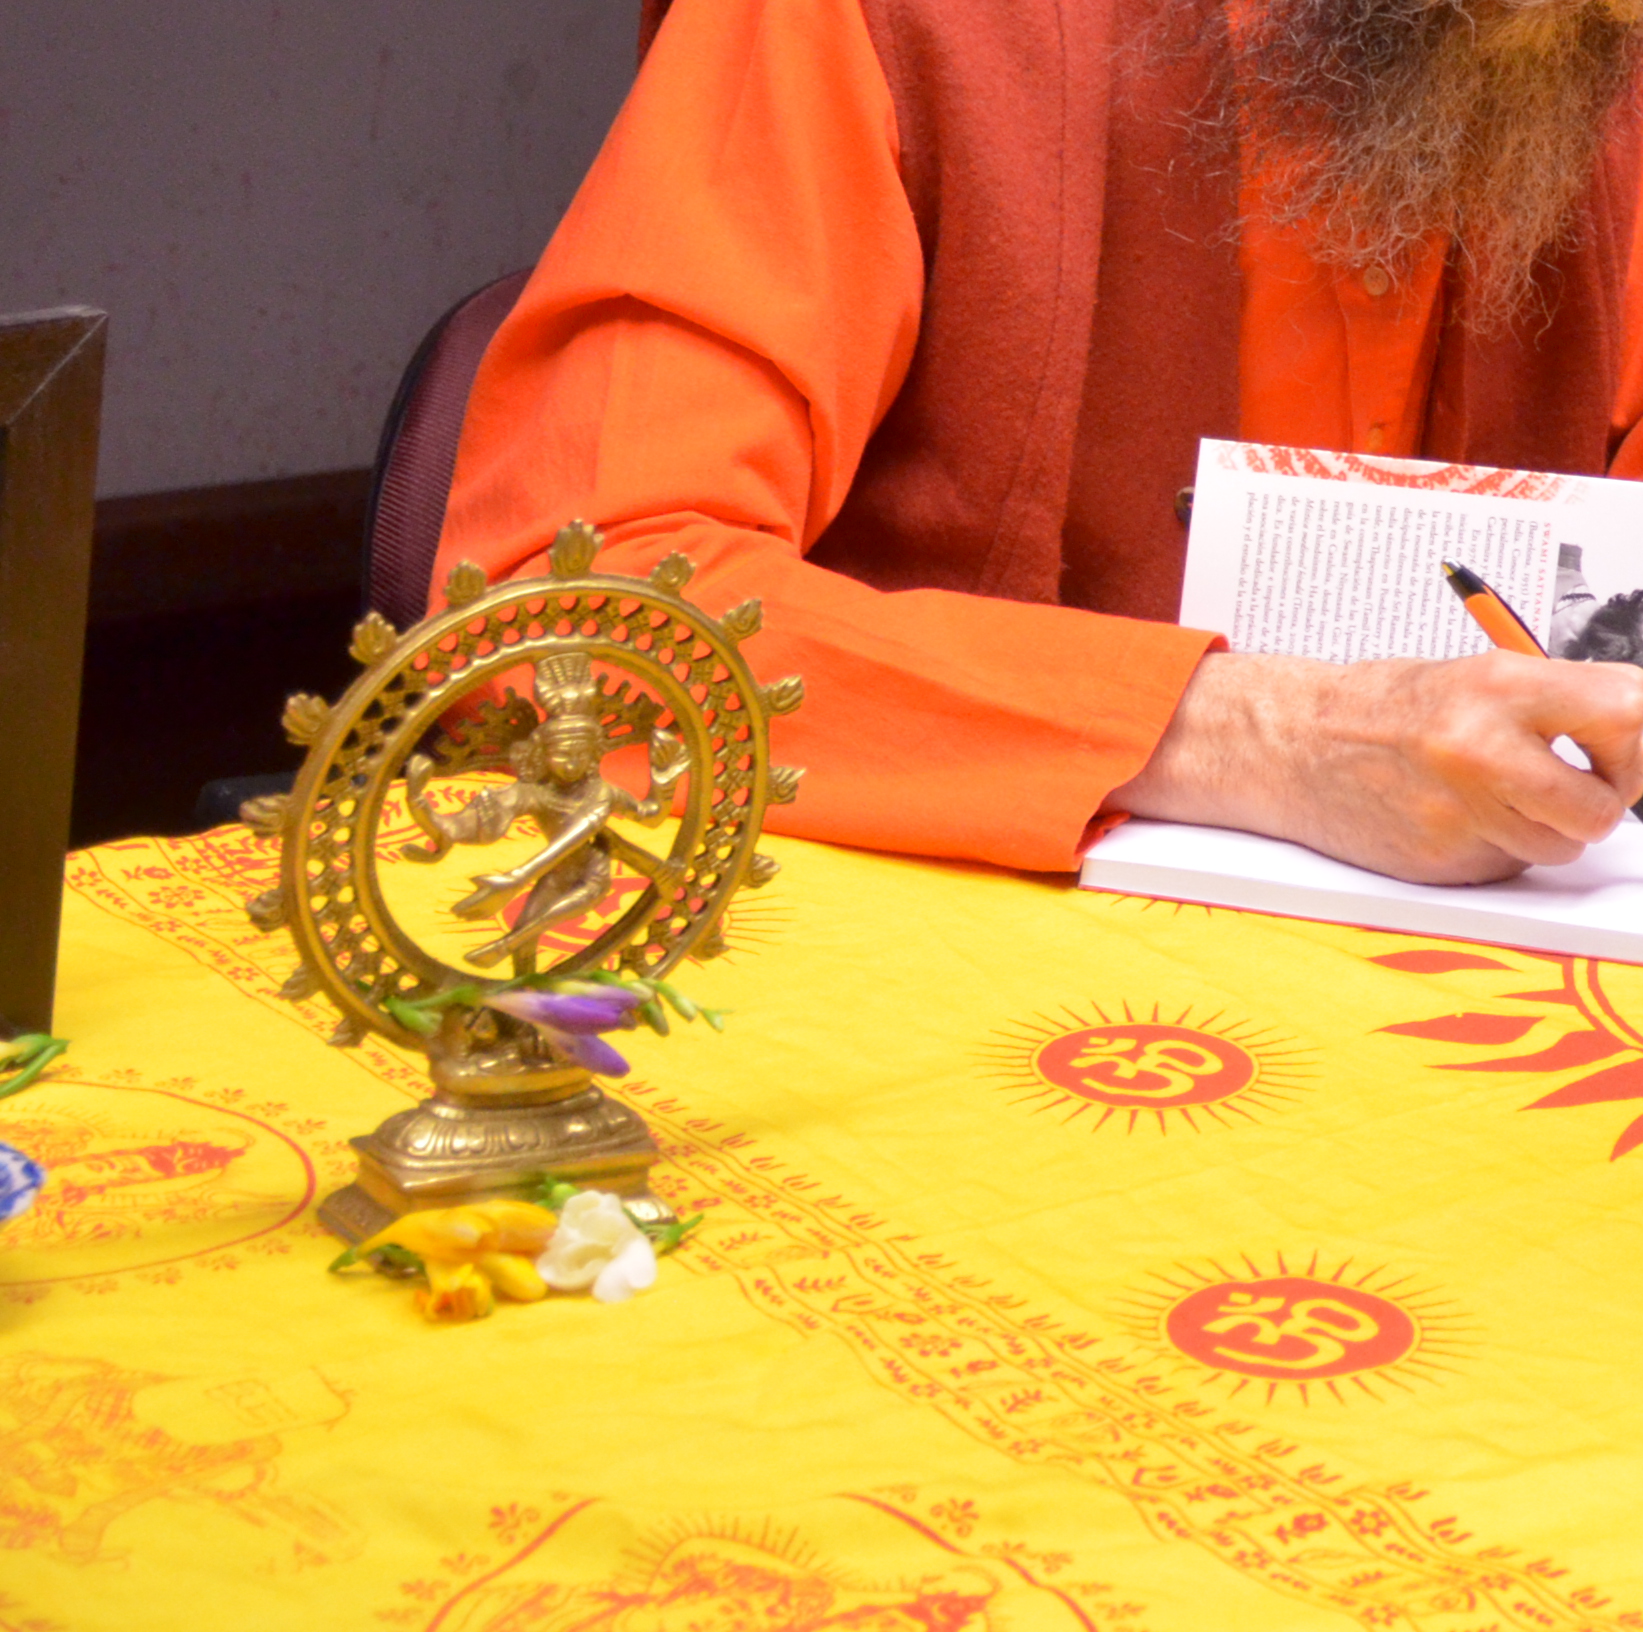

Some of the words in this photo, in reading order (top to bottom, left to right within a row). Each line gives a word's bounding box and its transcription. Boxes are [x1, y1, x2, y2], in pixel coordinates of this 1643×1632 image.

[1246, 491, 1256, 523] plación
[1275, 495, 1285, 514] dica.
[1291, 496, 1299, 507] de
[1302, 498, 1313, 529] Mística
[1318, 499, 1327, 521] sobre
[1331, 501, 1339, 525] reside
[1361, 503, 1367, 513] en
[1273, 519, 1282, 529] Es
[1287, 510, 1295, 533] varias
[1372, 505, 1383, 529] tarde,
[1417, 509, 1425, 519] de
[1443, 512, 1452, 536] recibe
[1244, 533, 1251, 541] el
[1256, 511, 1266, 555] asociación
[1316, 524, 1324, 532] el
[1329, 529, 1336, 539] en
[1344, 524, 1353, 534] de
[1372, 531, 1378, 542] en
[1428, 520, 1437, 545] orden
[1456, 513, 1466, 544] iniciará
[1470, 529, 1479, 541] En
[1482, 516, 1495, 562] Cachemira
[1513, 519, 1523, 543] India.
[1268, 533, 1280, 572] fundador
[1298, 530, 1308, 569] medieval
[1341, 539, 1351, 567] Swami
[1383, 532, 1394, 570] sánscrito
[1411, 534, 1420, 572] montaña
[1427, 548, 1435, 558] de
[1442, 540, 1450, 551] los
[1455, 547, 1461, 557] en
[1465, 543, 1476, 564] 1976
[1497, 517, 1507, 568] pecialmente
[1523, 520, 1537, 568] (Barcelona,
[1539, 522, 1551, 562] SWAMI
[1239, 543, 1249, 575] estudio
[1280, 536, 1292, 599] contribuciones
[1311, 533, 1324, 581] hinduismo.
[1322, 543, 1336, 584] Cataluña,
[1352, 528, 1364, 592] contemplación
[1395, 552, 1407, 586] directos
[1425, 562, 1434, 574] Sri
[1509, 548, 1520, 581] Conoce
[1238, 577, 1247, 587] de
[1251, 557, 1263, 595] dedicada
[1381, 573, 1388, 584] en
[1409, 576, 1418, 586] de
[1309, 585, 1318, 598] Ha
[1320, 588, 1331, 616] donde
[1350, 595, 1359, 606] de
[1394, 587, 1403, 597] de
[1420, 577, 1432, 617] Shankara.
[1436, 580, 1444, 604] como
[1262, 585, 1274, 623] impulsor
[1289, 596, 1302, 629] (Trotta,
[1305, 600, 1315, 632] editado
[1349, 609, 1358, 621] las
[1372, 587, 1388, 639] Pondicherry
[1392, 600, 1401, 612] Sri
[1404, 590, 1417, 639] Arunachala
[1448, 605, 1457, 614] de
[1520, 600, 1528, 609] ha
[1232, 600, 1243, 639] tradición
[1276, 609, 1286, 633] obras
[1362, 602, 1373, 631] (Tamil
[1419, 622, 1427, 631] Se
[1243, 613, 1255, 650] práctica,
[1261, 627, 1269, 637] de
[1274, 635, 1283, 646] de
[1315, 620, 1327, 654] imparte
[1332, 626, 1341, 646] Giri.
[1388, 615, 1400, 650] Ramana
[1430, 606, 1441, 657] renunciante
[1402, 642, 1408, 653] en
